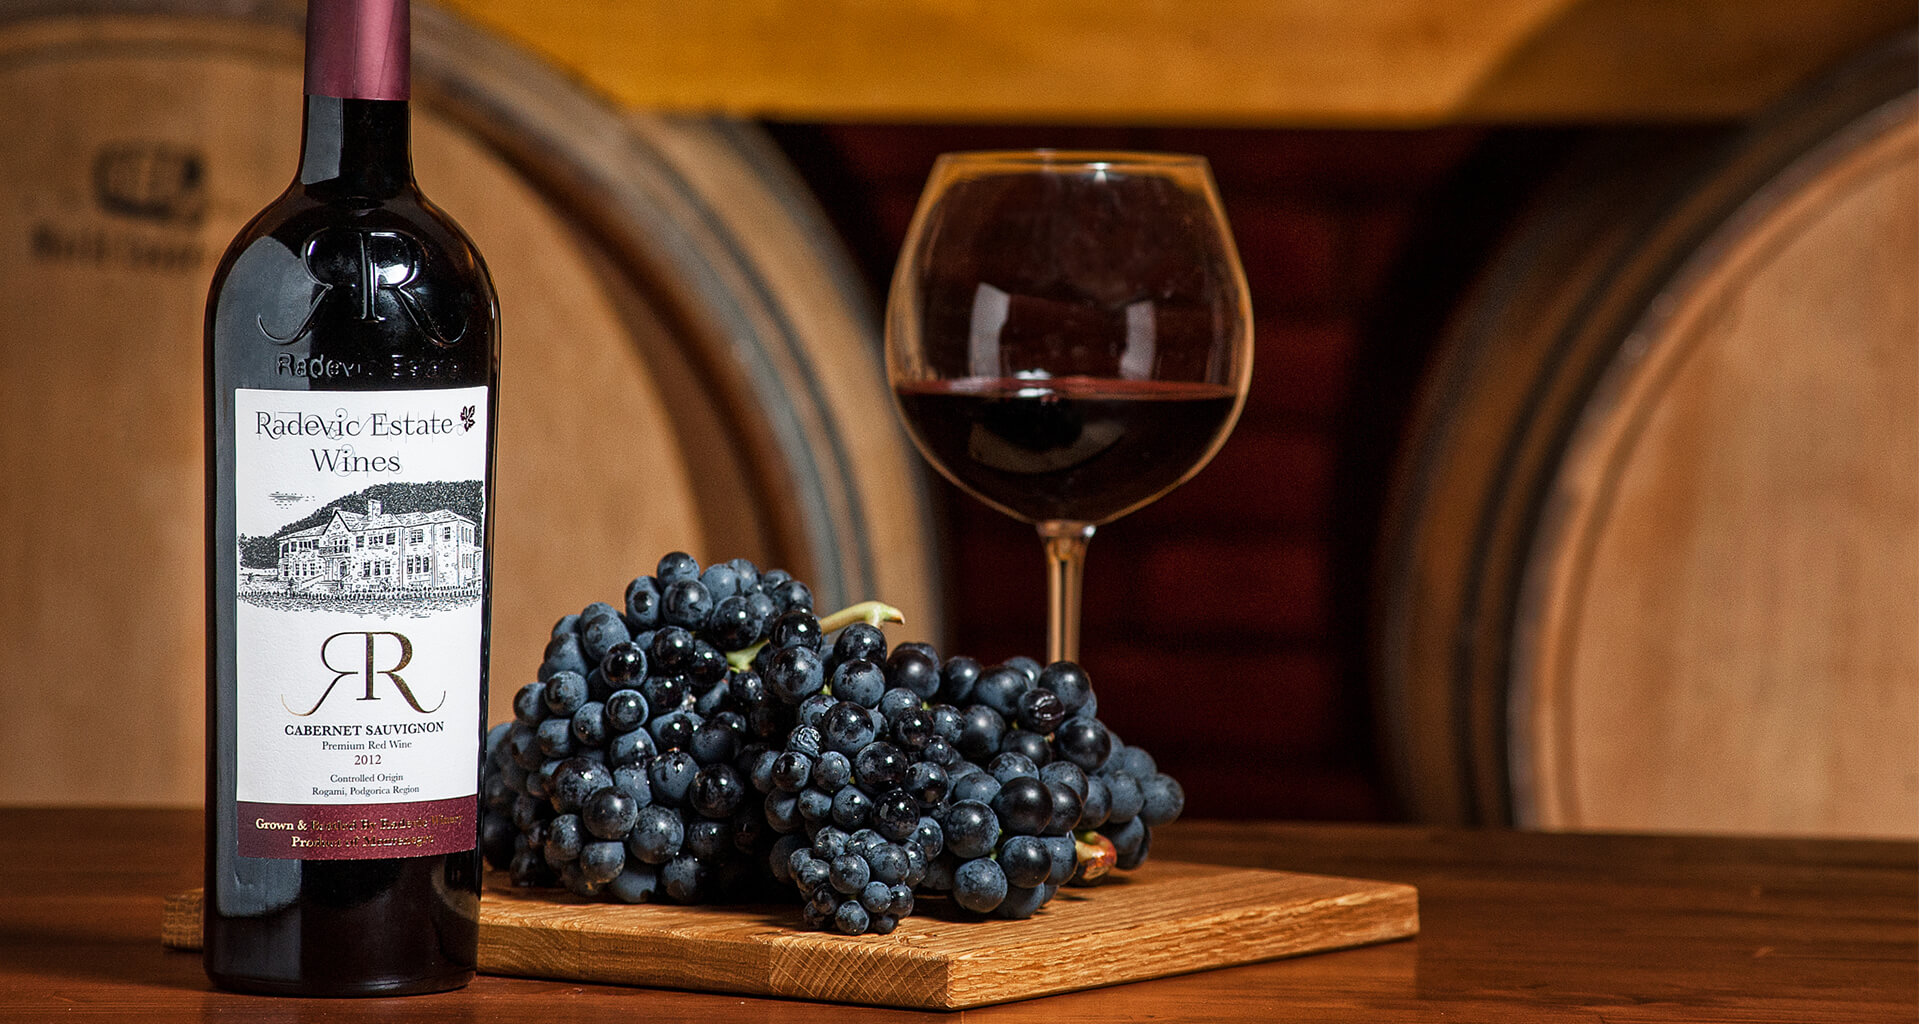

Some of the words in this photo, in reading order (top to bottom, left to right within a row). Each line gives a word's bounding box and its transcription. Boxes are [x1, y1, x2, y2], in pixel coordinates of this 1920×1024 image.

[255, 409, 362, 440] Radevic
[370, 411, 454, 437] Estate
[310, 447, 401, 473] Wines
[284, 724, 362, 737] CABERNET
[365, 721, 445, 736] SAUVIGNON
[322, 740, 365, 750] Premium
[368, 740, 387, 750] Red
[389, 739, 412, 749] Wine
[354, 755, 382, 766] 2012
[330, 773, 375, 783] Controlled
[377, 773, 404, 783] Origin
[312, 787, 348, 797] Rogami,
[350, 786, 391, 796] Podgorica
[393, 785, 420, 795] Region
[255, 818, 294, 831] Grown
[297, 819, 307, 831] &
[360, 820, 376, 833] By
[345, 836, 359, 847] of
